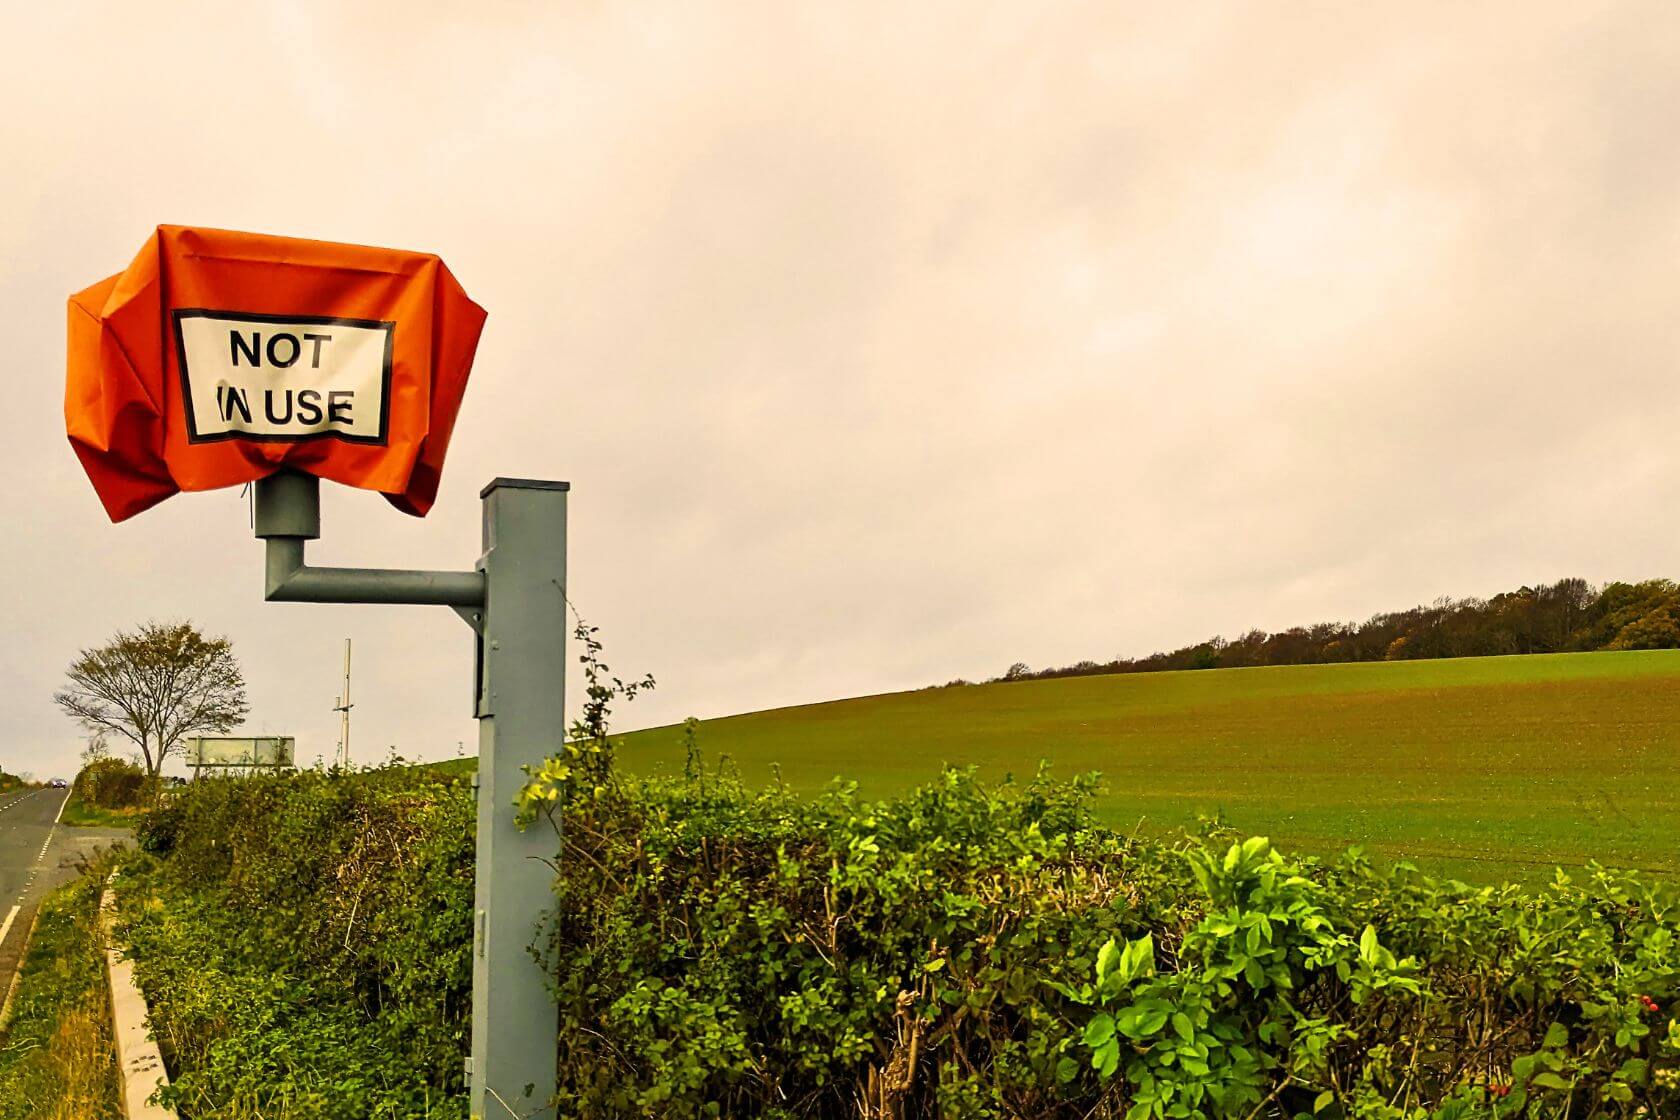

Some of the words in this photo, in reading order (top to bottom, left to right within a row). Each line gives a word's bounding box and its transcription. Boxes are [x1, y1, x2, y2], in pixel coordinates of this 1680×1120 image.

[230, 330, 332, 368] NOT
[217, 386, 252, 423] IN
[264, 390, 354, 425] USE
